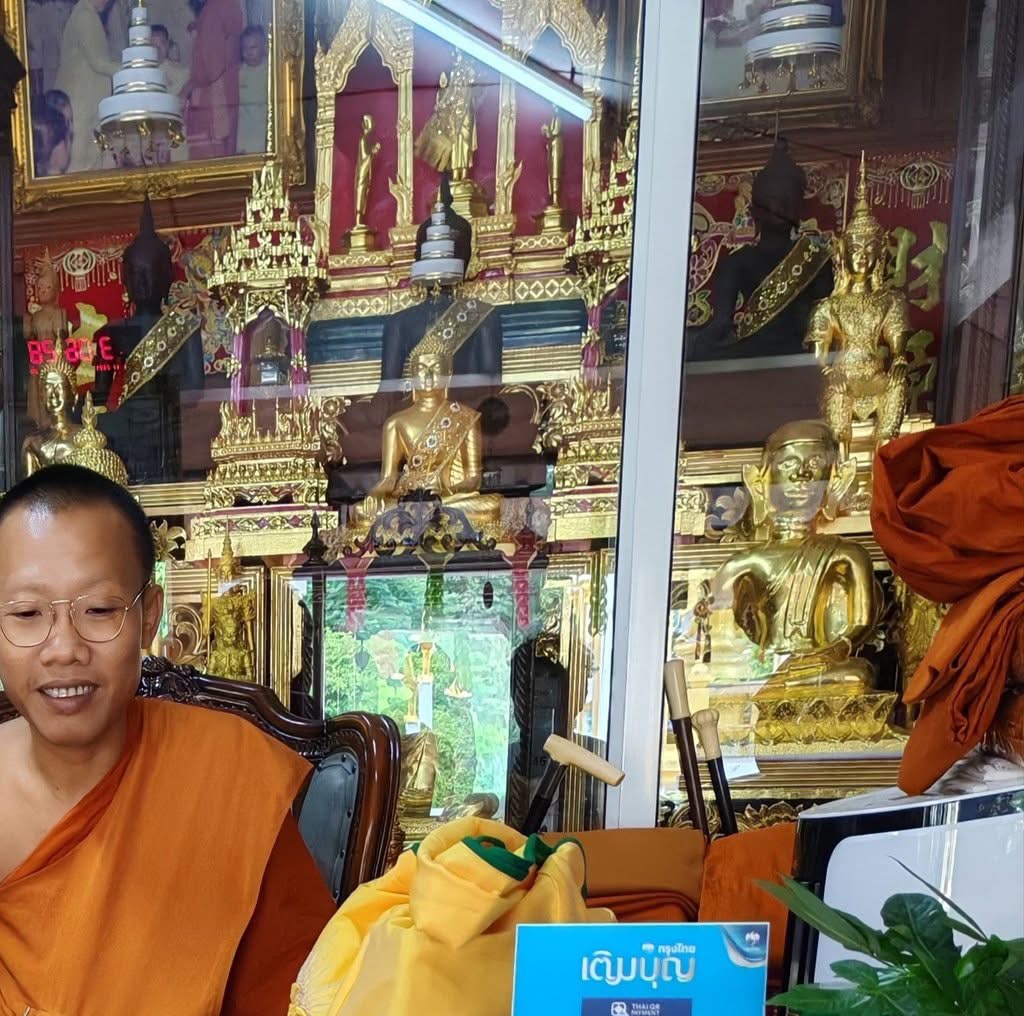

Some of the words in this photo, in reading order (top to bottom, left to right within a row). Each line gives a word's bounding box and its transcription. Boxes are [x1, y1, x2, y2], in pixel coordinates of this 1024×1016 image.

[658, 943, 696, 956] กรุงไทย
[581, 950, 696, 989] เติมบุญ
